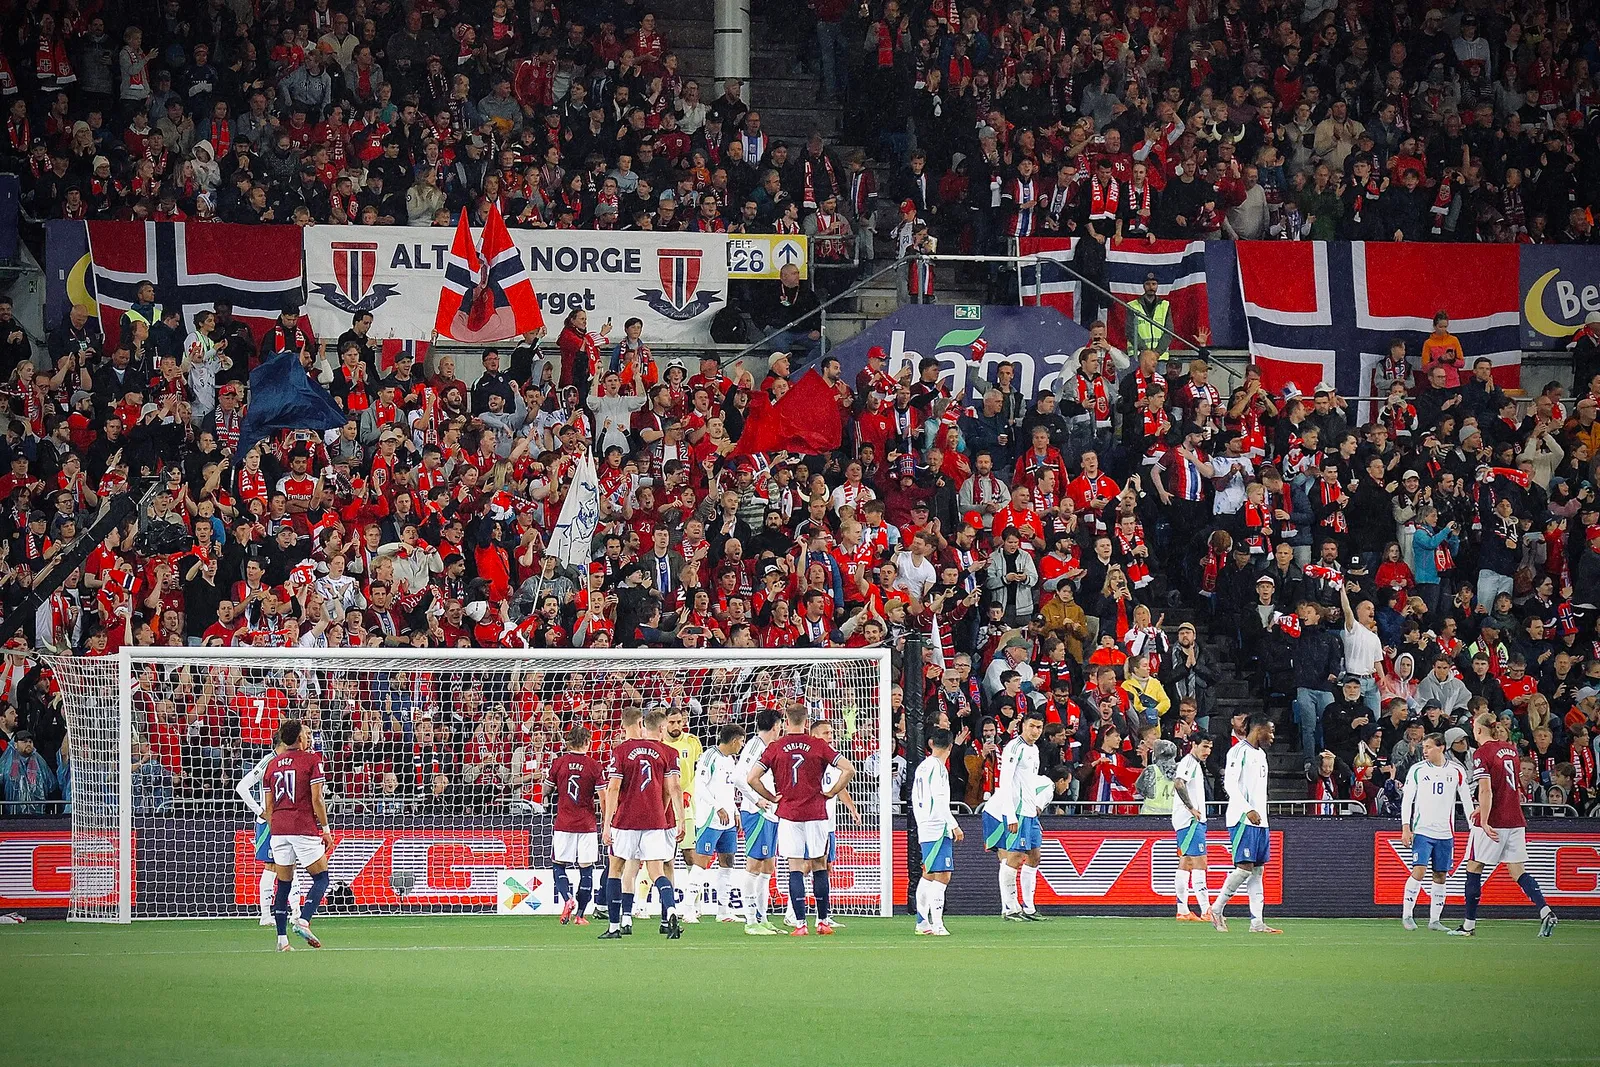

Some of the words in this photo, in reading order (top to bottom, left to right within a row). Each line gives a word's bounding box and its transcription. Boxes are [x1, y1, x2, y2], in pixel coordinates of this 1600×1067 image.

[1115, 162, 1125, 172] 96
[390, 243, 449, 270] ALT
[530, 246, 642, 274] NORGE
[728, 240, 752, 249] FELT
[728, 249, 764, 272] 28
[536, 288, 596, 315] rget
[1556, 280, 1600, 320] Be
[888, 331, 1070, 400] bama
[287, 492, 312, 501] Emirates
[640, 521, 651, 533] 23
[253, 699, 265, 724] 7
[791, 753, 805, 788] 7
[1503, 759, 1517, 792] 9
[273, 769, 296, 803] 20
[1432, 782, 1444, 795] 18
[1037, 838, 1250, 896] VG
[1387, 839, 1600, 897] VG
